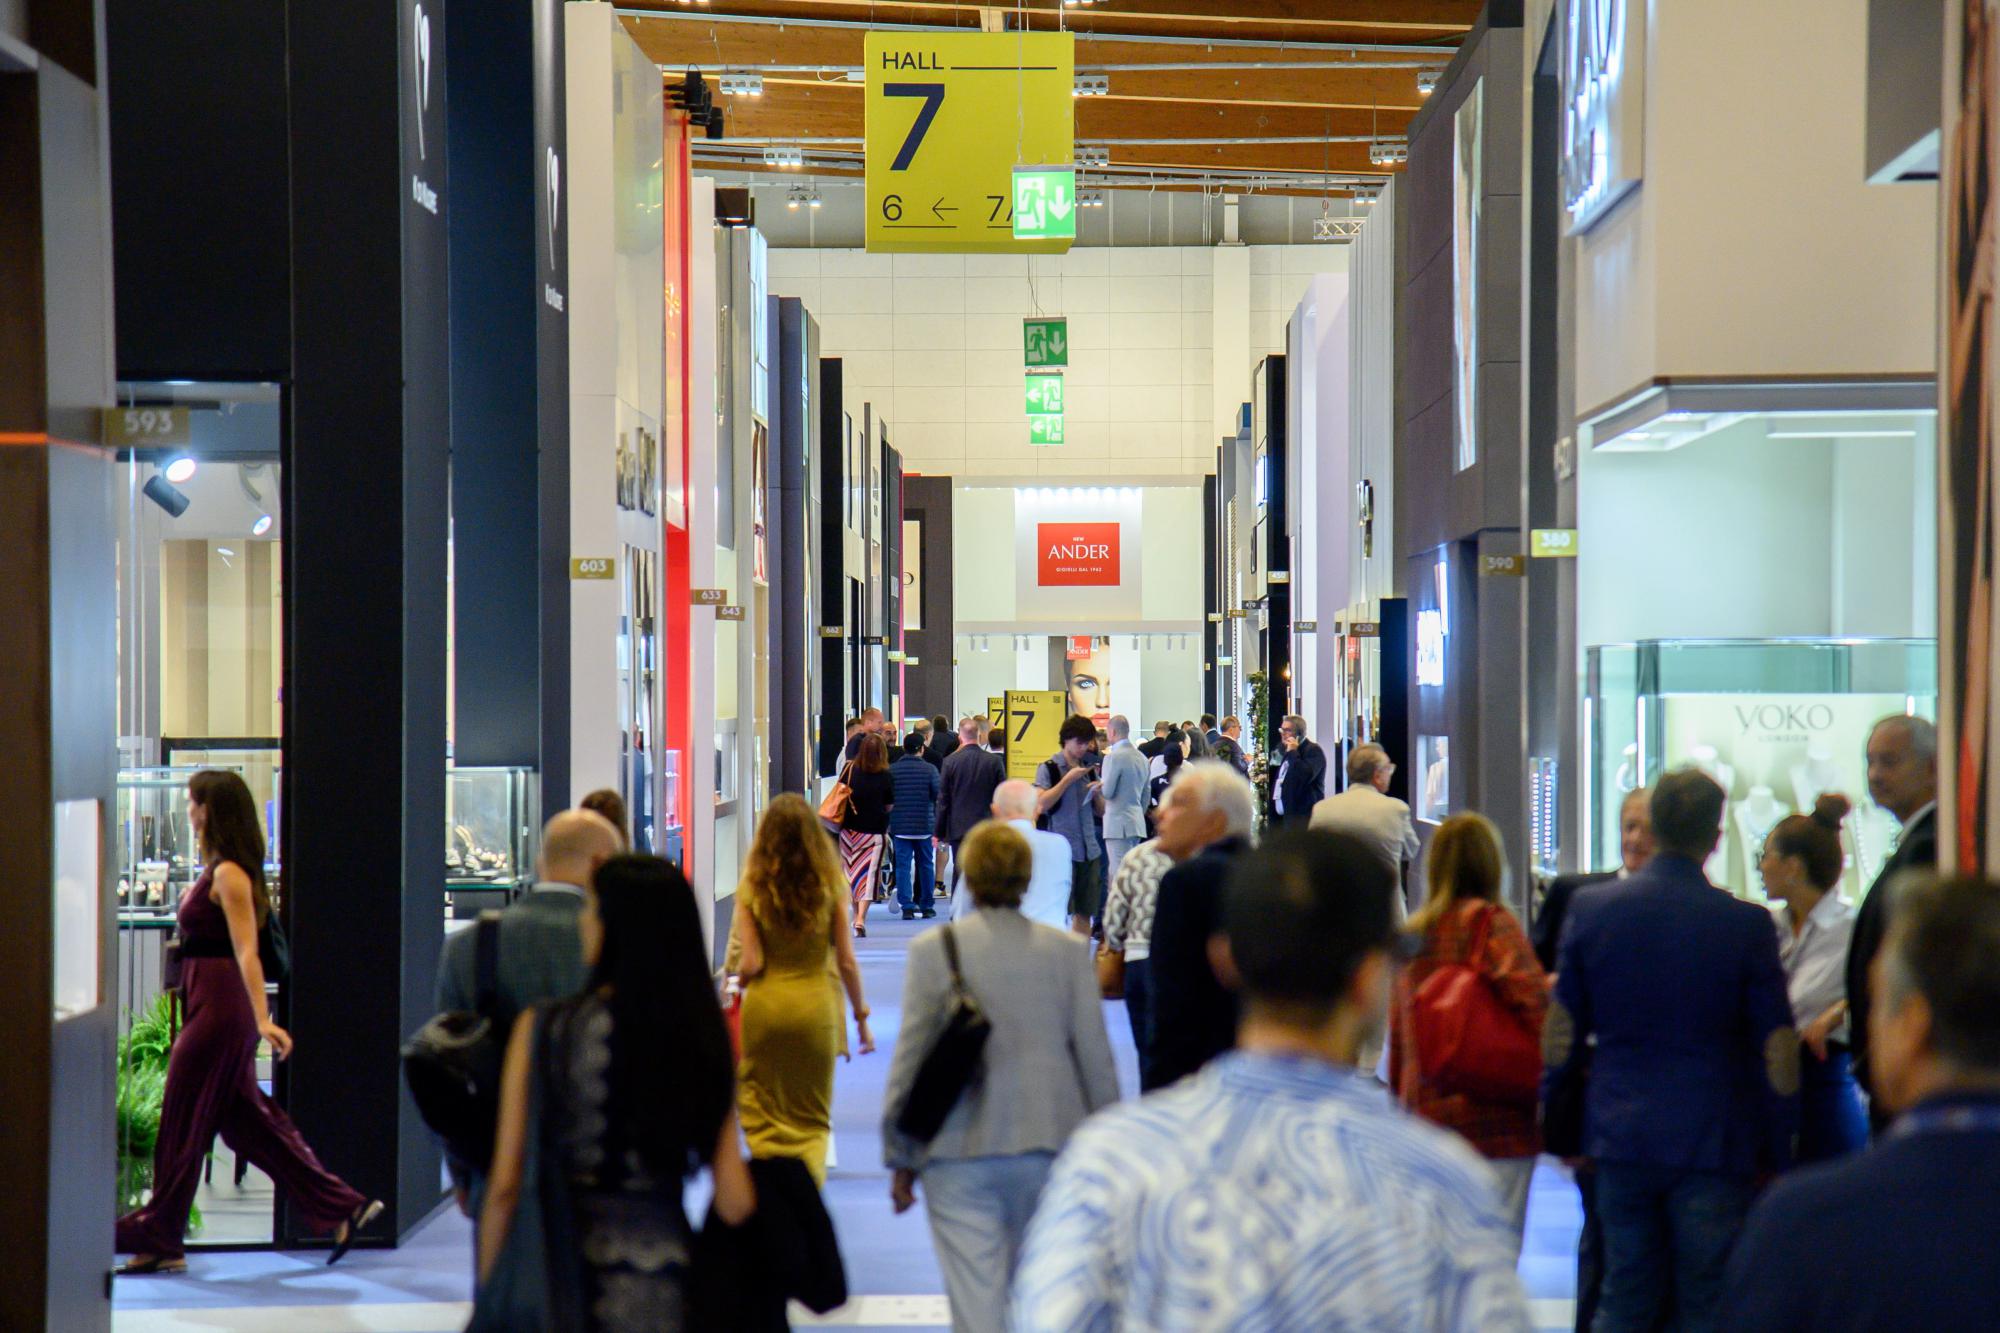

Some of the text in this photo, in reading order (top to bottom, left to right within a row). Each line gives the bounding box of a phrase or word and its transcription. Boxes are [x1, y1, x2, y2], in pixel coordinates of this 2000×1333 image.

[882, 51, 945, 70] HALL
[883, 83, 945, 171] 7
[882, 194, 903, 222] 6
[124, 409, 173, 433] 593
[1540, 532, 1571, 548] 380
[1048, 544, 1110, 559] ANDER
[579, 559, 608, 573] 603
[1486, 557, 1515, 570] 390
[701, 590, 722, 600] 633
[721, 606, 740, 616] 643
[1011, 695, 1038, 704] HALL
[1011, 711, 1035, 741] 7
[1734, 703, 1834, 735] YOKO
